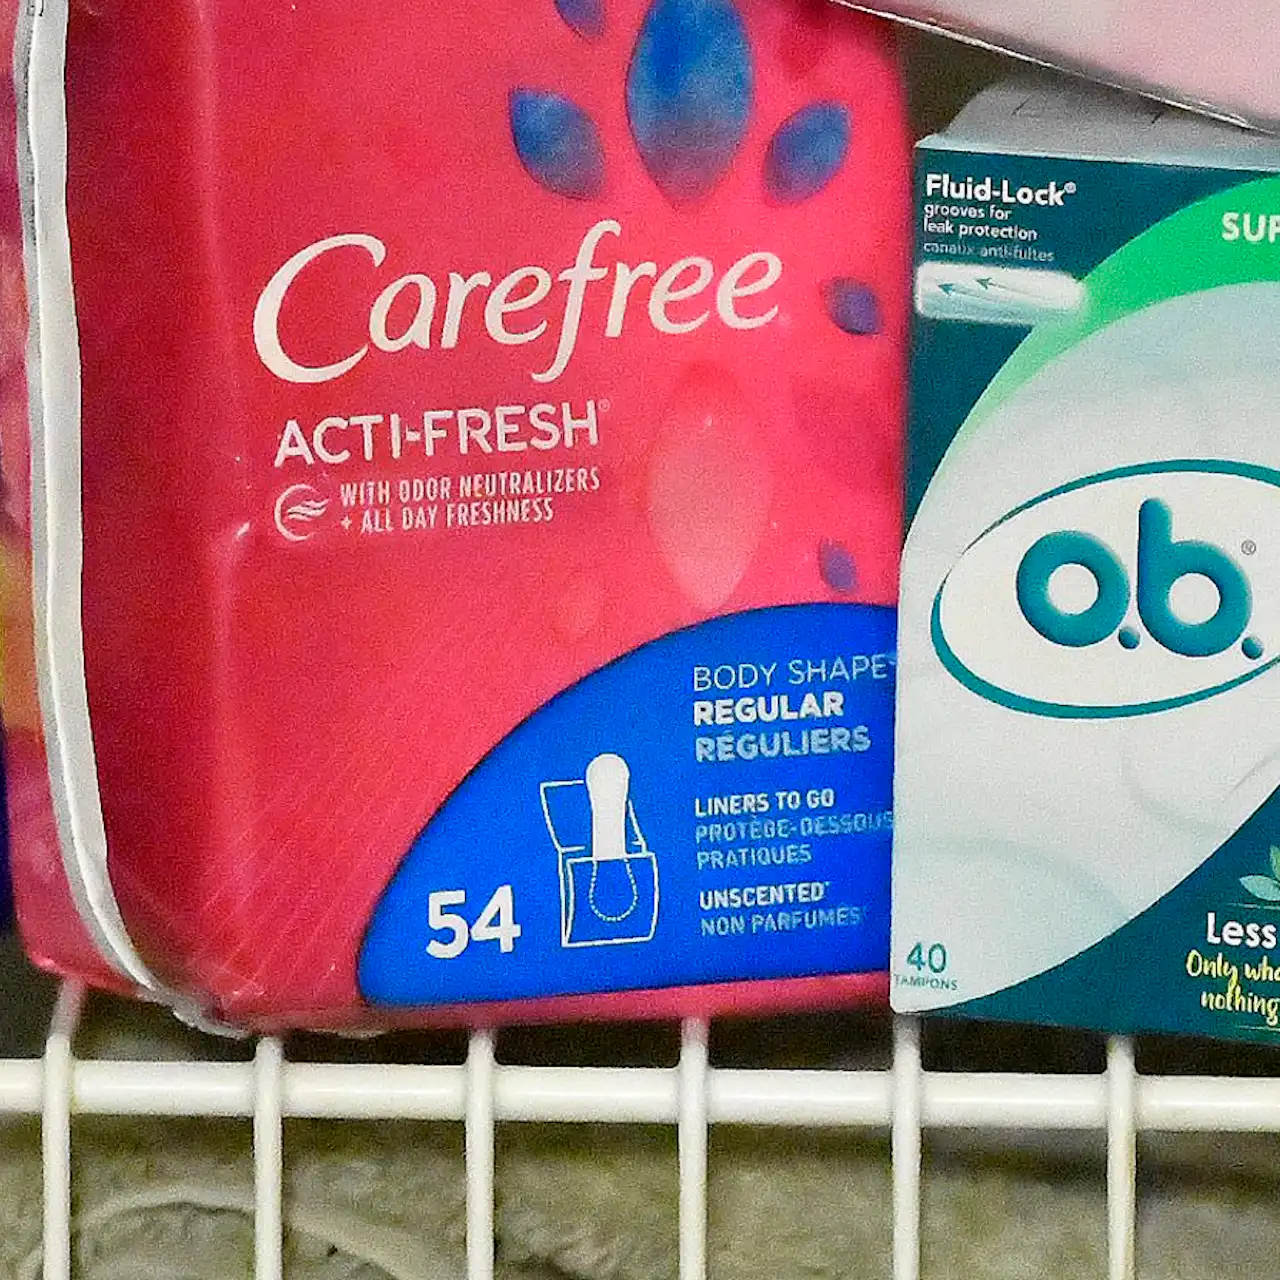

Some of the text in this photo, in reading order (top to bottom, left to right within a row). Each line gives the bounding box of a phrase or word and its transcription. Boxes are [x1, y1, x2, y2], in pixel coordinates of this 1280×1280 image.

[925, 173, 1065, 206] Fluid-Lock
[923, 204, 1012, 222] grooves for
[923, 217, 1038, 241] leak protection
[252, 218, 783, 384] Carefree
[274, 401, 599, 468] ACTI-FRESH
[340, 466, 601, 507] WITH ODOR NEUTRALIZERS
[359, 508, 394, 535] ALL
[400, 505, 437, 531] DAY
[446, 497, 554, 528] FRESHNESS
[694, 654, 888, 692] BODY SHAPE
[694, 691, 844, 727] REGULAR
[695, 787, 836, 818] LINERS TO GO
[696, 843, 813, 871] PRATIQUES
[699, 881, 825, 911] UNSCENTED
[425, 884, 522, 960] 54
[700, 913, 746, 937] NON
[1207, 911, 1278, 949] Less
[907, 942, 948, 974] 40
[1186, 949, 1239, 995] Only
[894, 973, 958, 991] TAMPONS
[1200, 984, 1279, 1026] nothing
